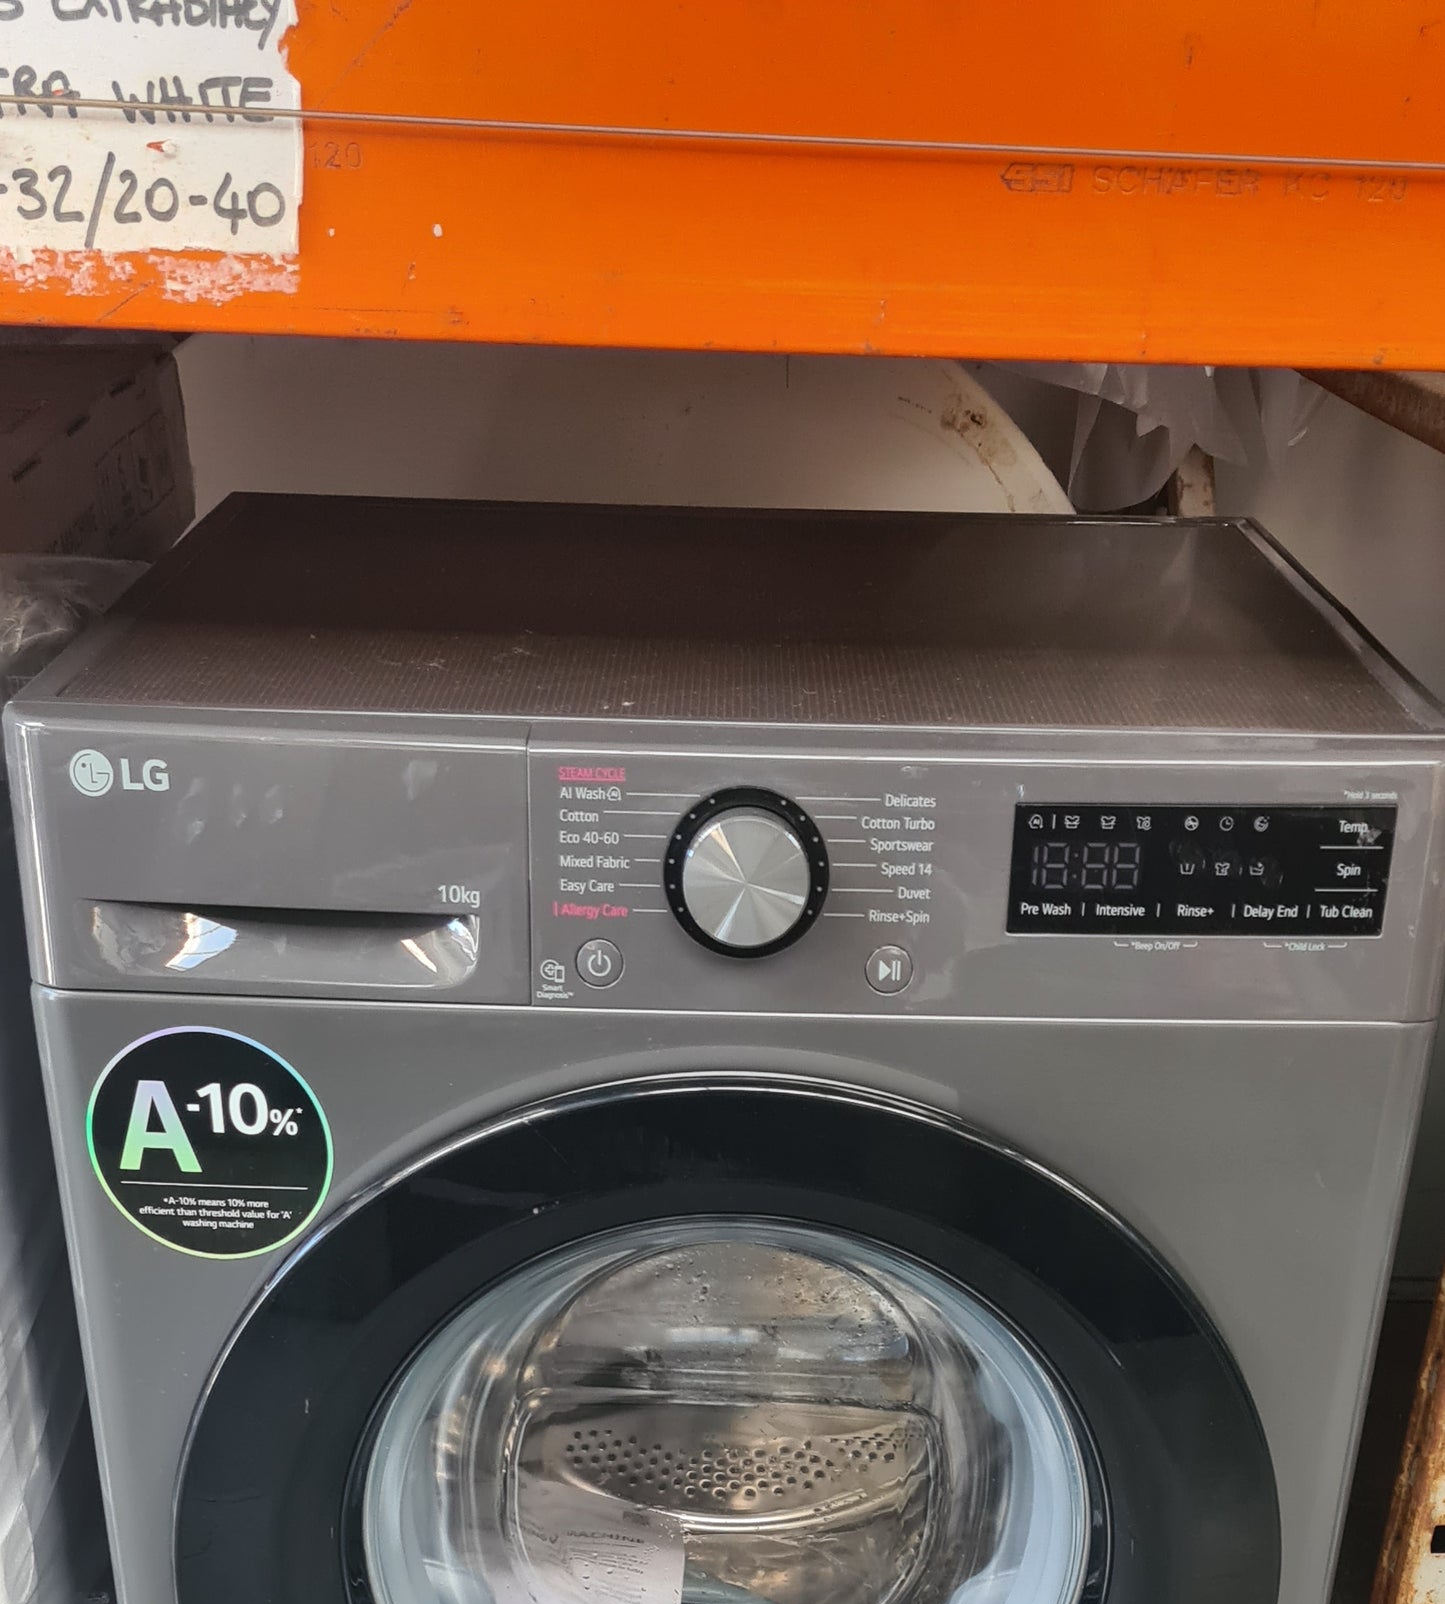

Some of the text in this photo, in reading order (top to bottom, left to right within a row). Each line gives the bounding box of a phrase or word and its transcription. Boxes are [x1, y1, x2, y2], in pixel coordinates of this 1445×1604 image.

[112, 75, 274, 124] WHITE
[120, 758, 170, 792] LG
[559, 767, 626, 779] STEAM CYCLE
[575, 786, 606, 800] Wash
[885, 793, 937, 808] Delicates
[560, 808, 599, 822] Cotton
[861, 815, 935, 830] Cotton Turbo
[560, 830, 620, 844] Eco 40-60
[870, 837, 934, 854] Sportswear
[560, 855, 630, 869] Mixed Fabric
[881, 862, 933, 878] Speed 14
[1336, 863, 1361, 879] Spin
[560, 879, 615, 895] Easy Care
[898, 886, 932, 900] Duvet
[438, 884, 480, 908] 10kg
[561, 903, 628, 919] Allergy Care
[1020, 902, 1071, 916] Pre Wash
[1096, 904, 1146, 917] Intensive
[1177, 904, 1214, 918] Rinse+
[1243, 904, 1298, 920] Delay End
[1320, 905, 1373, 919] Tub Clean
[869, 909, 930, 926] Rinse+Spin
[1308, 942, 1325, 951] Lock
[198, 1199, 226, 1208] means
[227, 1198, 246, 1207] 10%
[246, 1200, 270, 1209] more
[139, 1206, 175, 1217] efficient
[176, 1207, 197, 1217] than
[198, 1207, 241, 1219] threshold
[241, 1209, 265, 1219] value
[266, 1209, 280, 1219] for
[182, 1218, 255, 1230] washing machine
